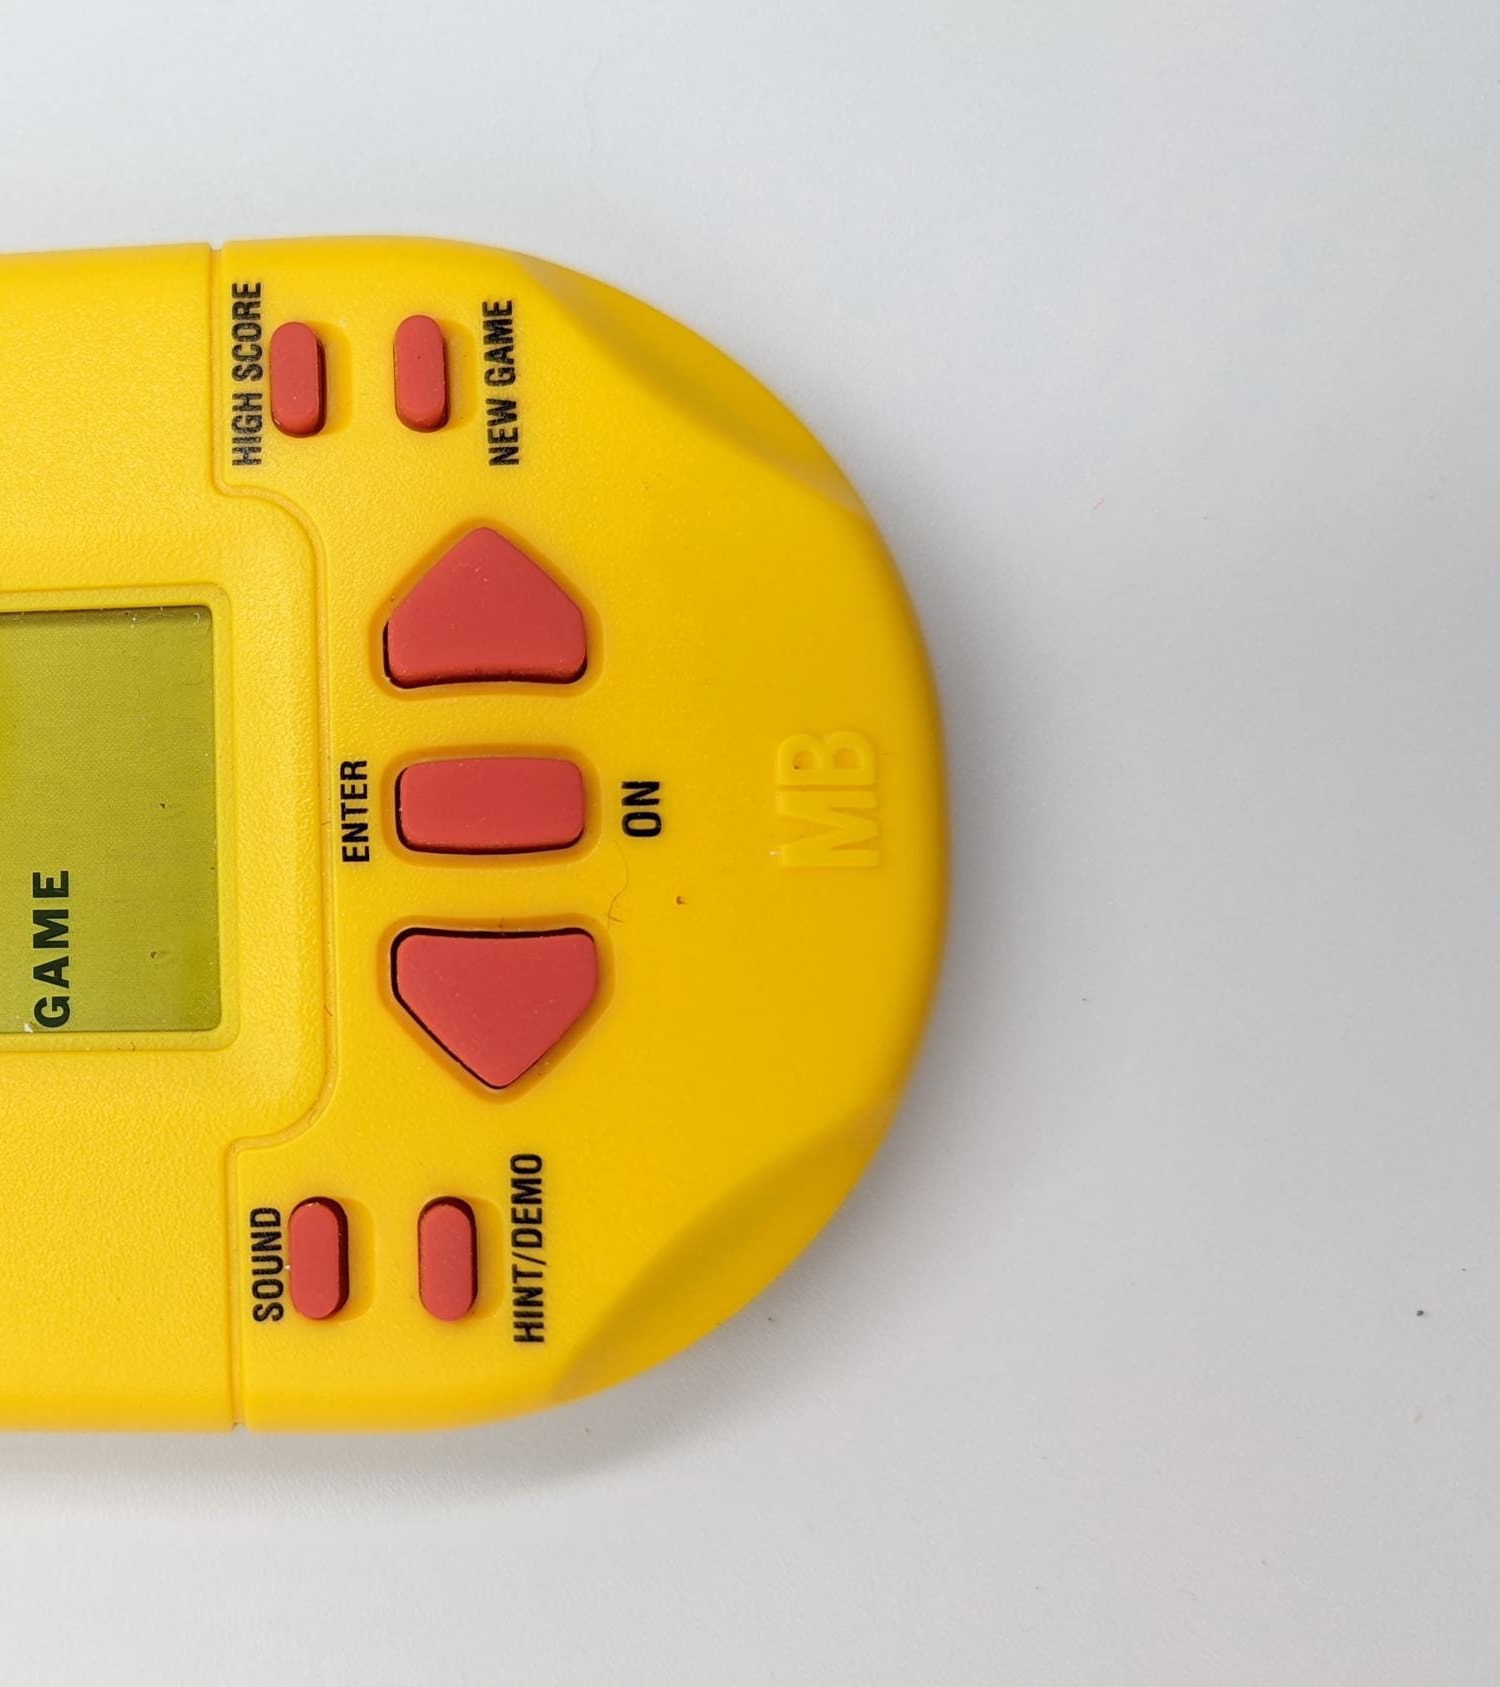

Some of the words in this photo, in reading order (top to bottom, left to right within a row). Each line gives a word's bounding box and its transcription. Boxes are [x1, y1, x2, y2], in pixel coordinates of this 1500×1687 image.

[231, 282, 263, 382] SCORE
[481, 299, 516, 387] GAME
[231, 392, 263, 466] HIGH
[485, 397, 520, 466] NEW
[340, 759, 371, 862] ENTER
[621, 780, 662, 838] ON
[777, 730, 881, 869] MB
[32, 869, 70, 1029] GAME
[250, 1206, 284, 1322] SOUND
[509, 1153, 547, 1343] HINT/DEMO
